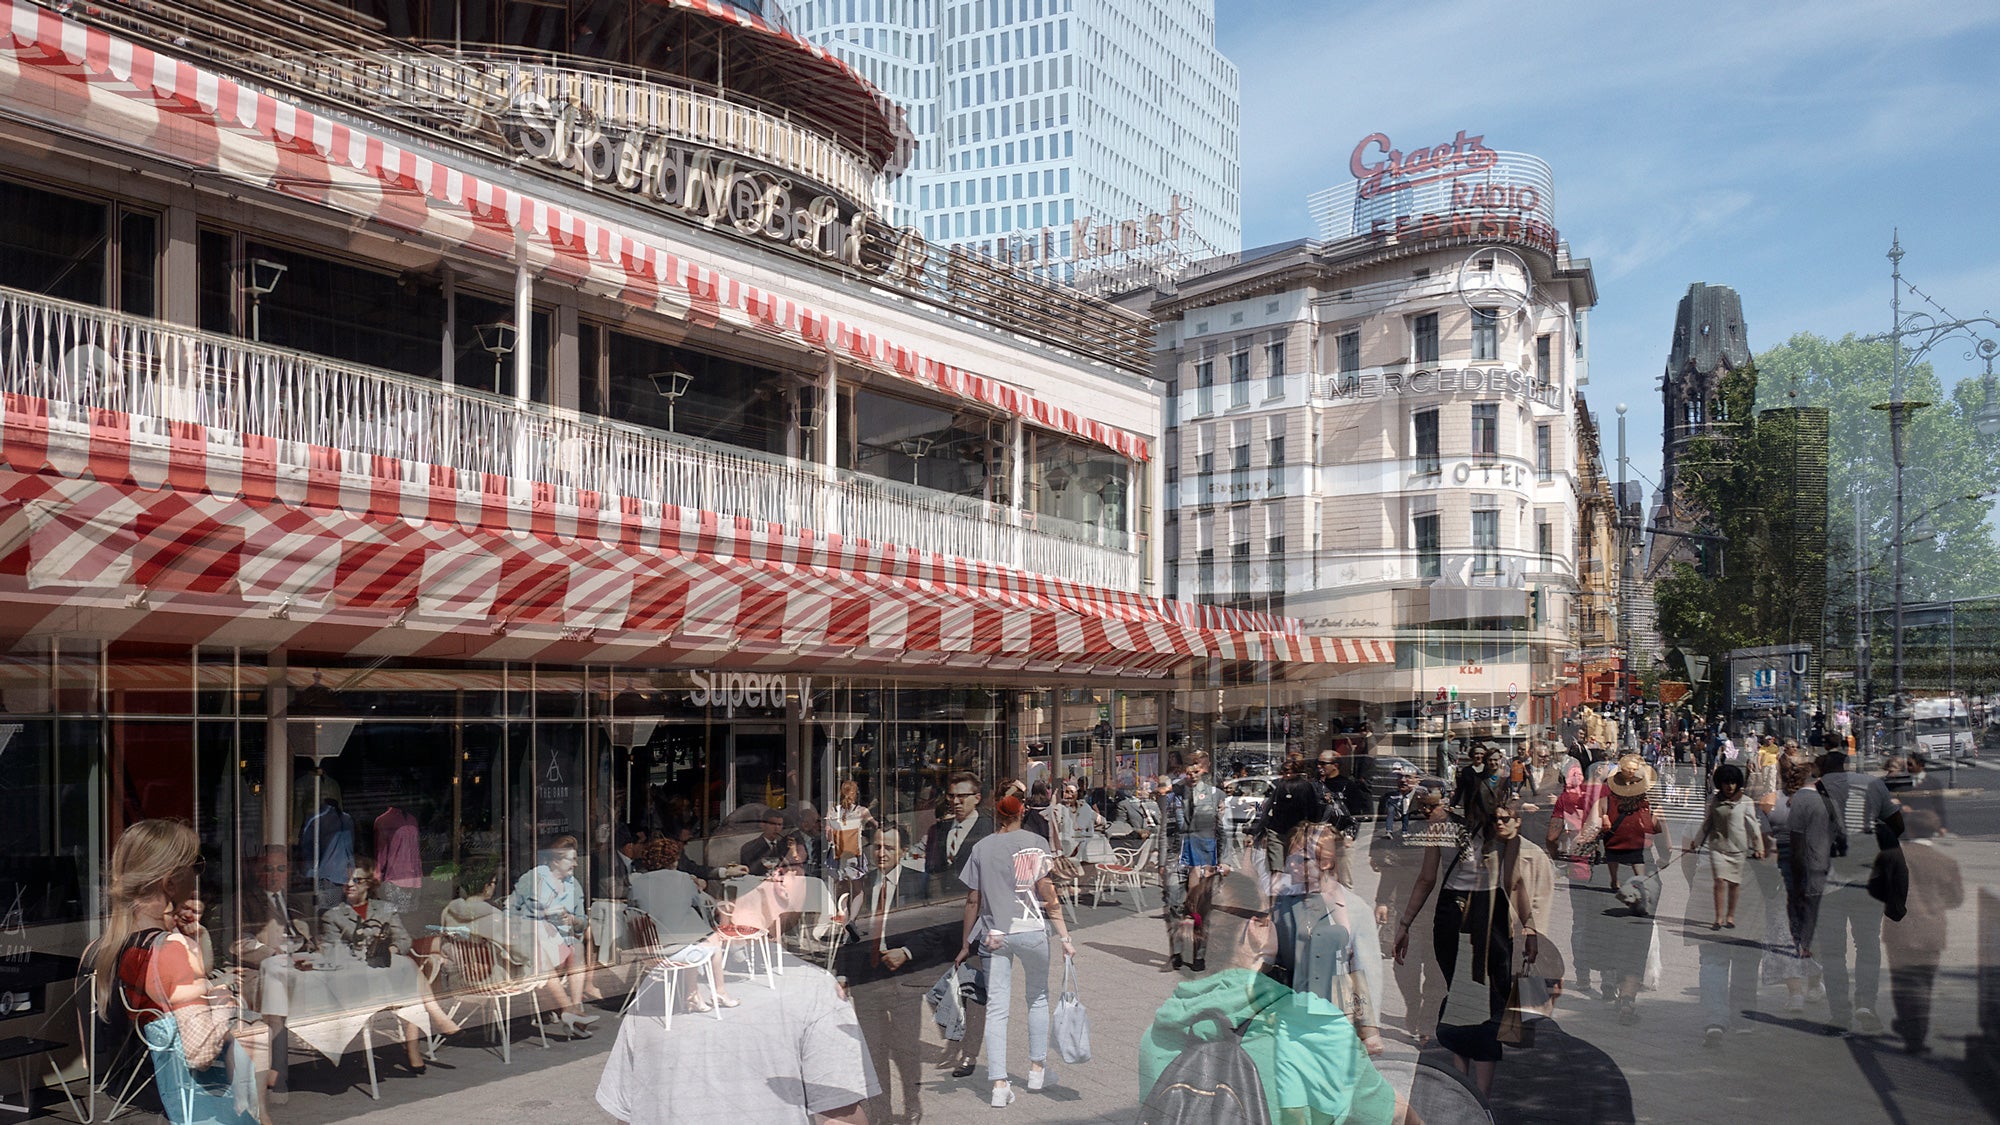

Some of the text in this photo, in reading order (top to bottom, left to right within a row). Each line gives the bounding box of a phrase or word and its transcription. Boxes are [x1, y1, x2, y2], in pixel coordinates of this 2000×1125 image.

[1349, 129, 1498, 200] Graetz
[1451, 181, 1540, 212] RADIO
[1327, 367, 1523, 401] MERCEDES
[1459, 666, 1483, 675] KLM
[1791, 653, 1807, 674] U
